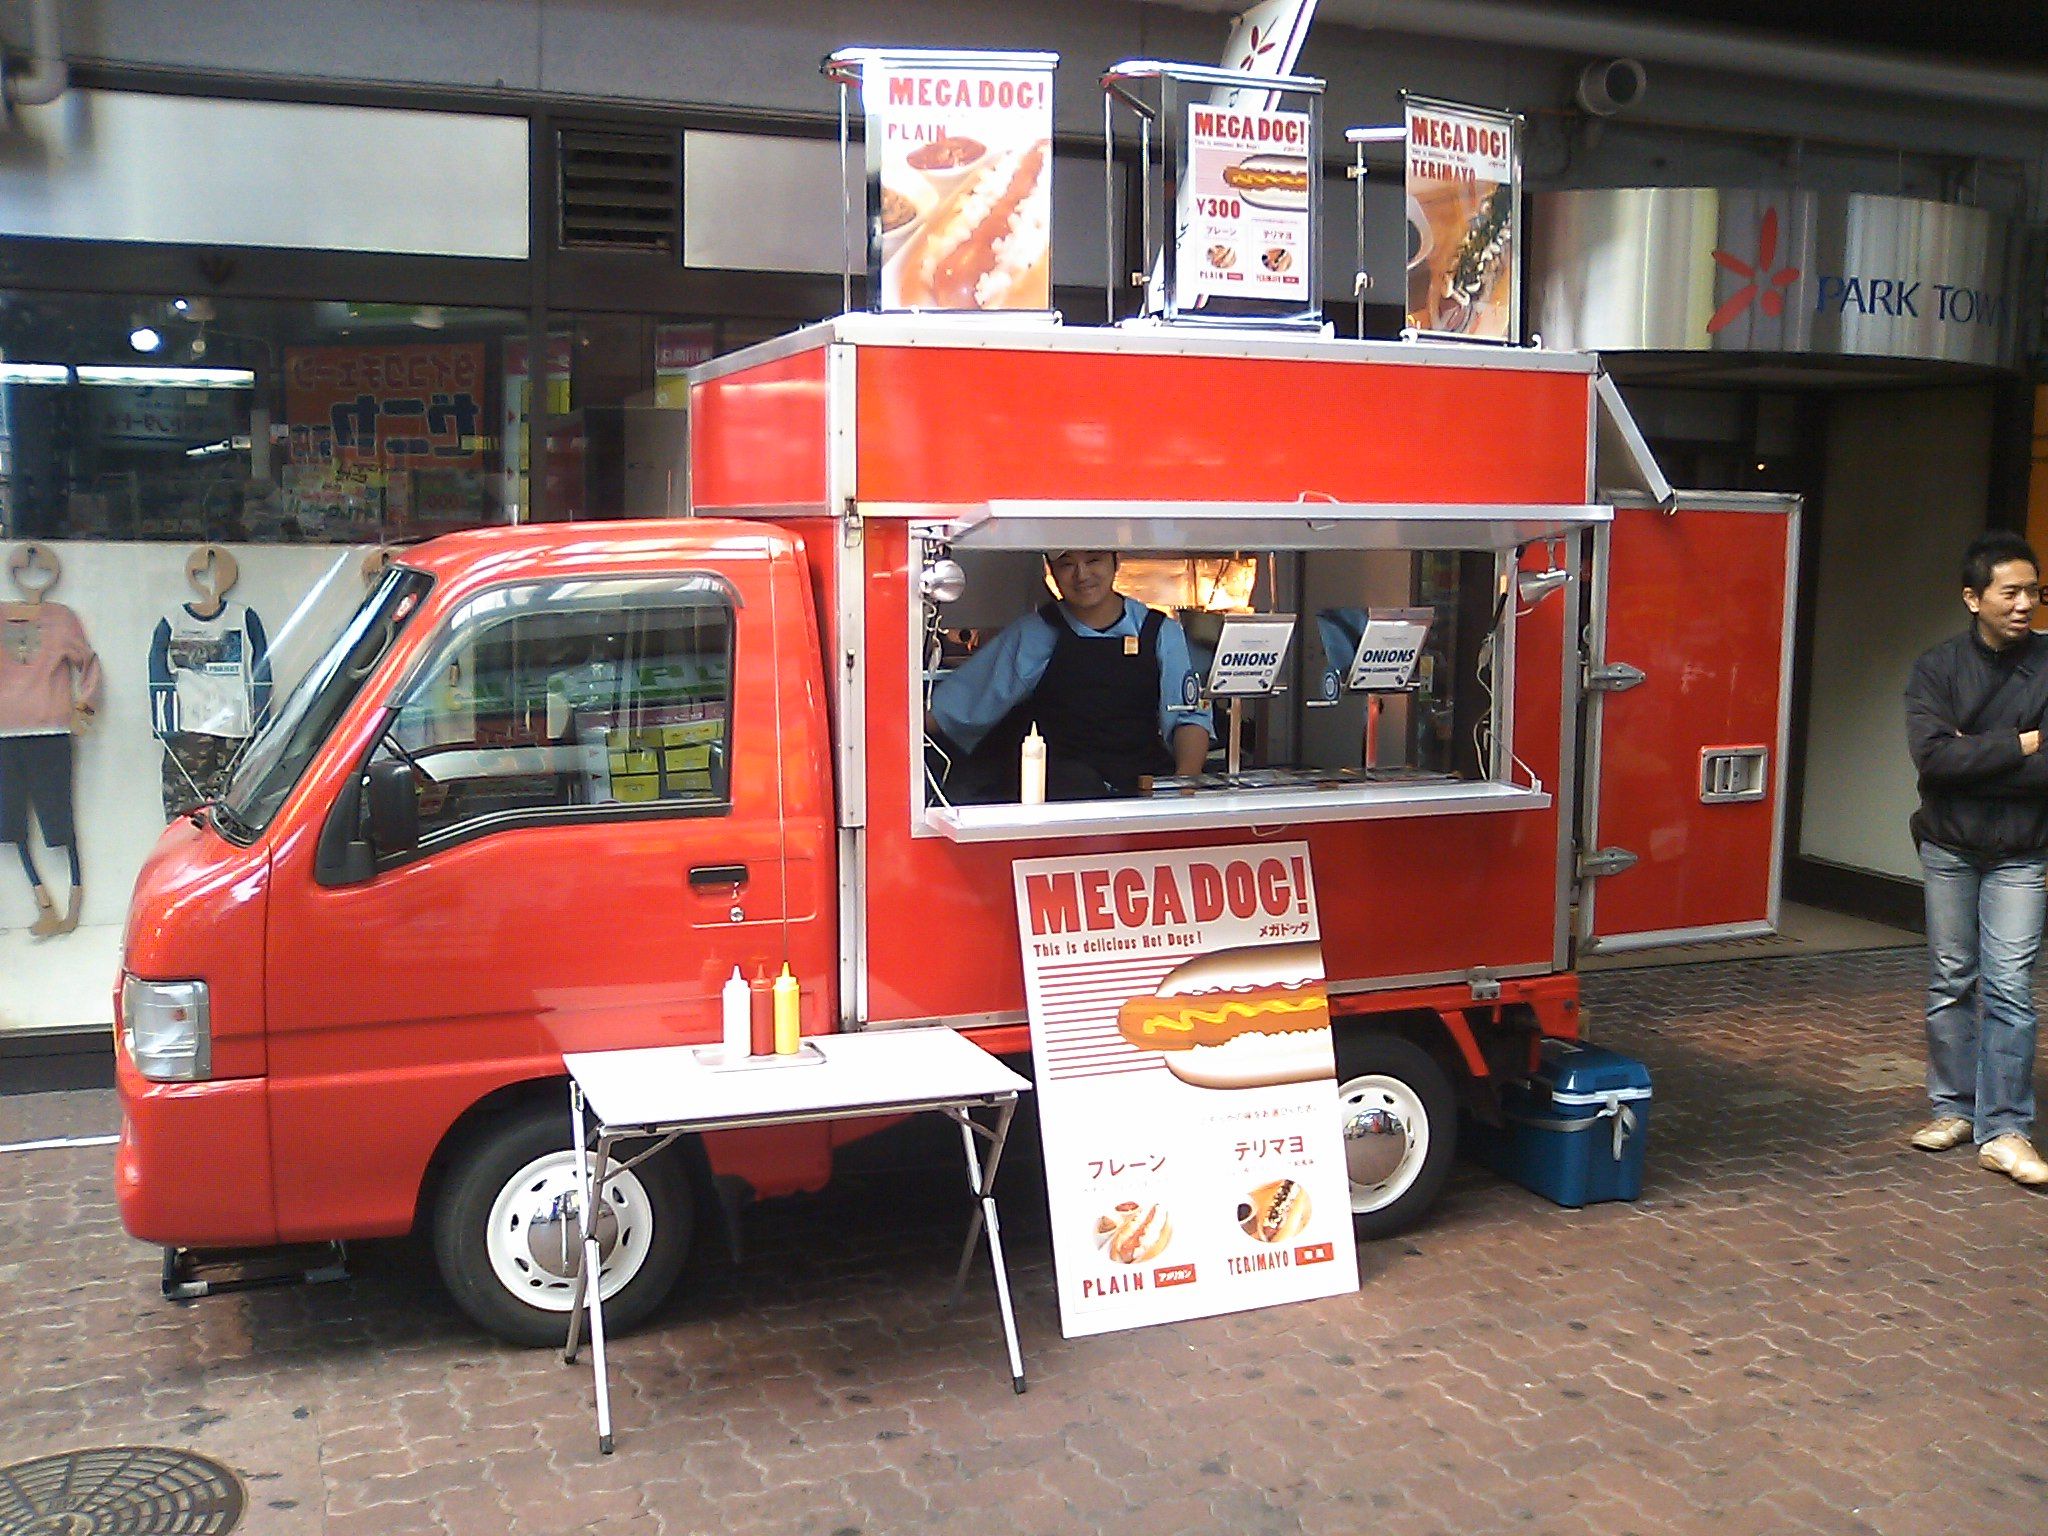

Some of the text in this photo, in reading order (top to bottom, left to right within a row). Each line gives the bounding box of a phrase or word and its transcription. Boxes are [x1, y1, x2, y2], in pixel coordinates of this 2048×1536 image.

[888, 123, 947, 141] PLAIN
[1412, 159, 1476, 186] TERIMAYO
[1817, 276, 1919, 318] PARK
[1221, 652, 1278, 667] ONIONS
[1362, 649, 1415, 663] ONIONS
[1026, 864, 1187, 935] MEGA
[1033, 943, 1060, 957] This
[1067, 941, 1077, 955] is
[1083, 936, 1137, 953] delicious
[1142, 934, 1162, 948] Hot
[1235, 1136, 1304, 1160] テリマヨ
[1228, 1250, 1289, 1276] TERIMAYO
[1083, 1272, 1144, 1298] PLAIN
